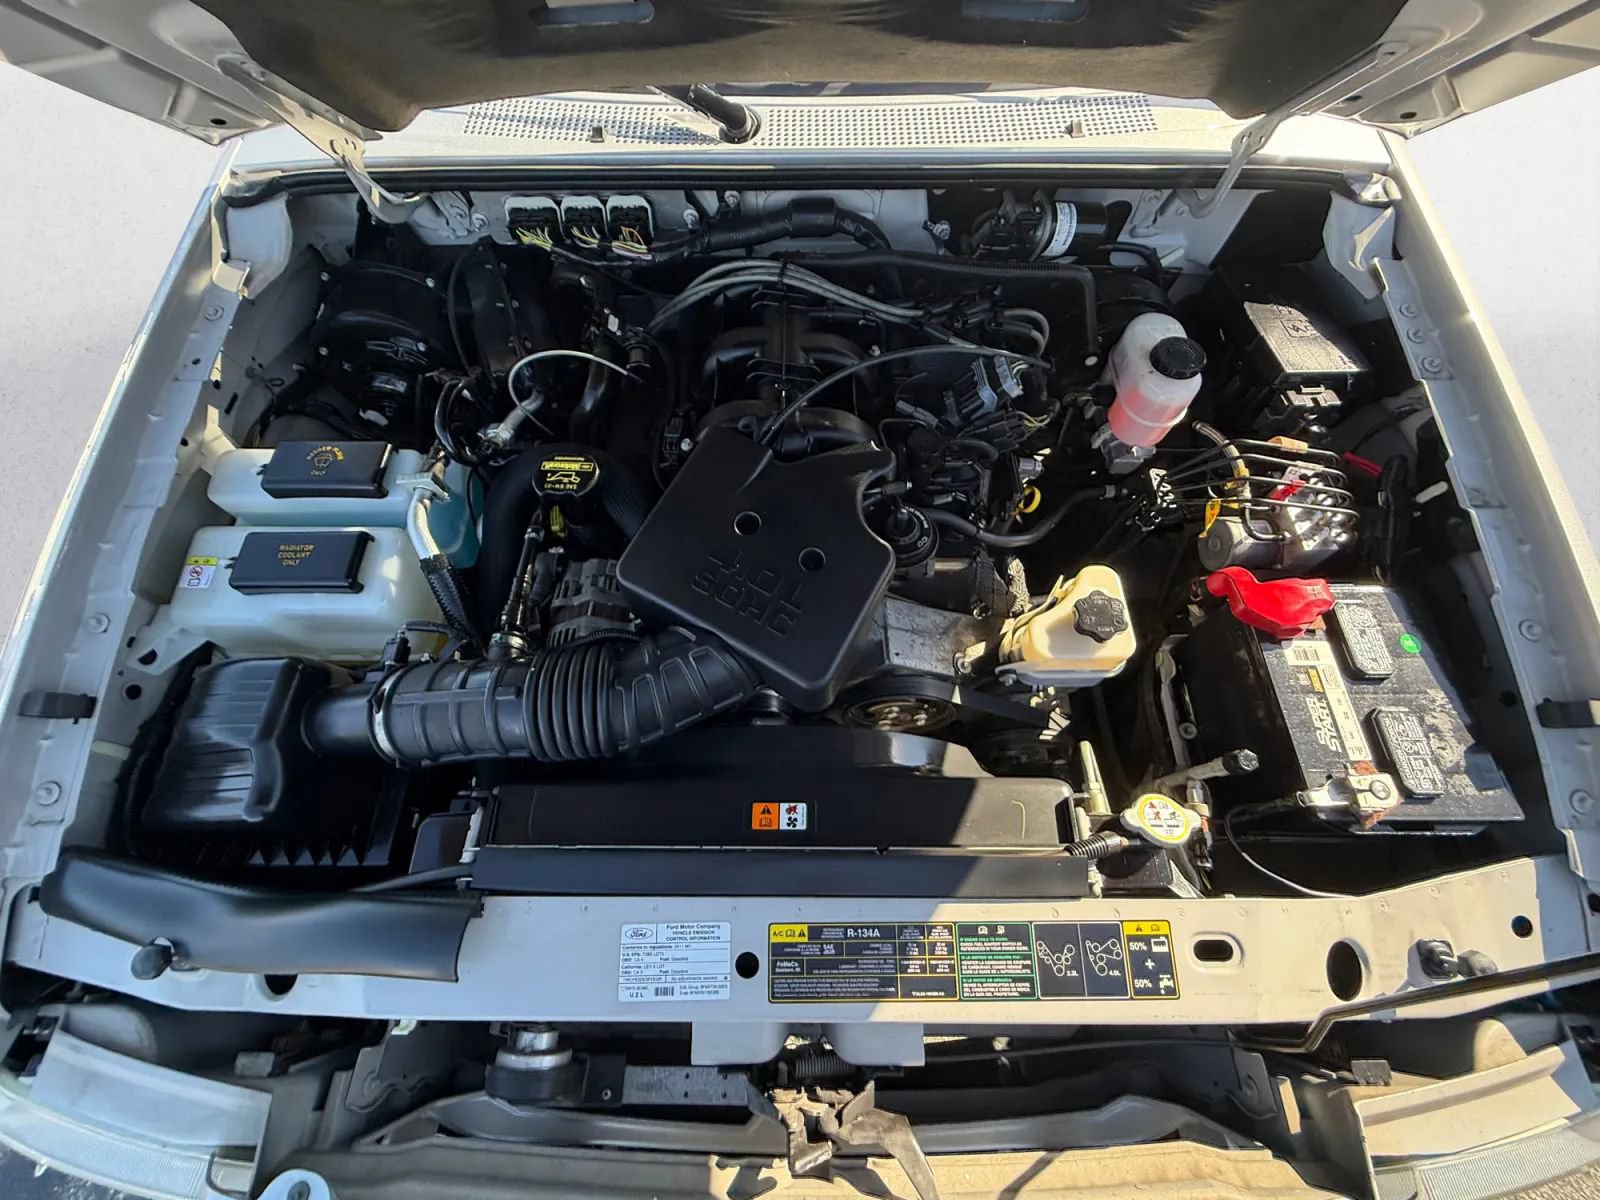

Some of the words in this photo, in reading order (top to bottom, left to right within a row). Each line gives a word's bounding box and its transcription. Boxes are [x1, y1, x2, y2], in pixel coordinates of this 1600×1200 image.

[277, 551, 312, 559] COOLANT
[689, 572, 795, 638] SOHC
[1305, 697, 1328, 746] SUPER
[1315, 697, 1343, 752] START
[847, 928, 880, 937] R-134A
[1129, 941, 1147, 951] 50%
[1134, 978, 1152, 988] 50%
